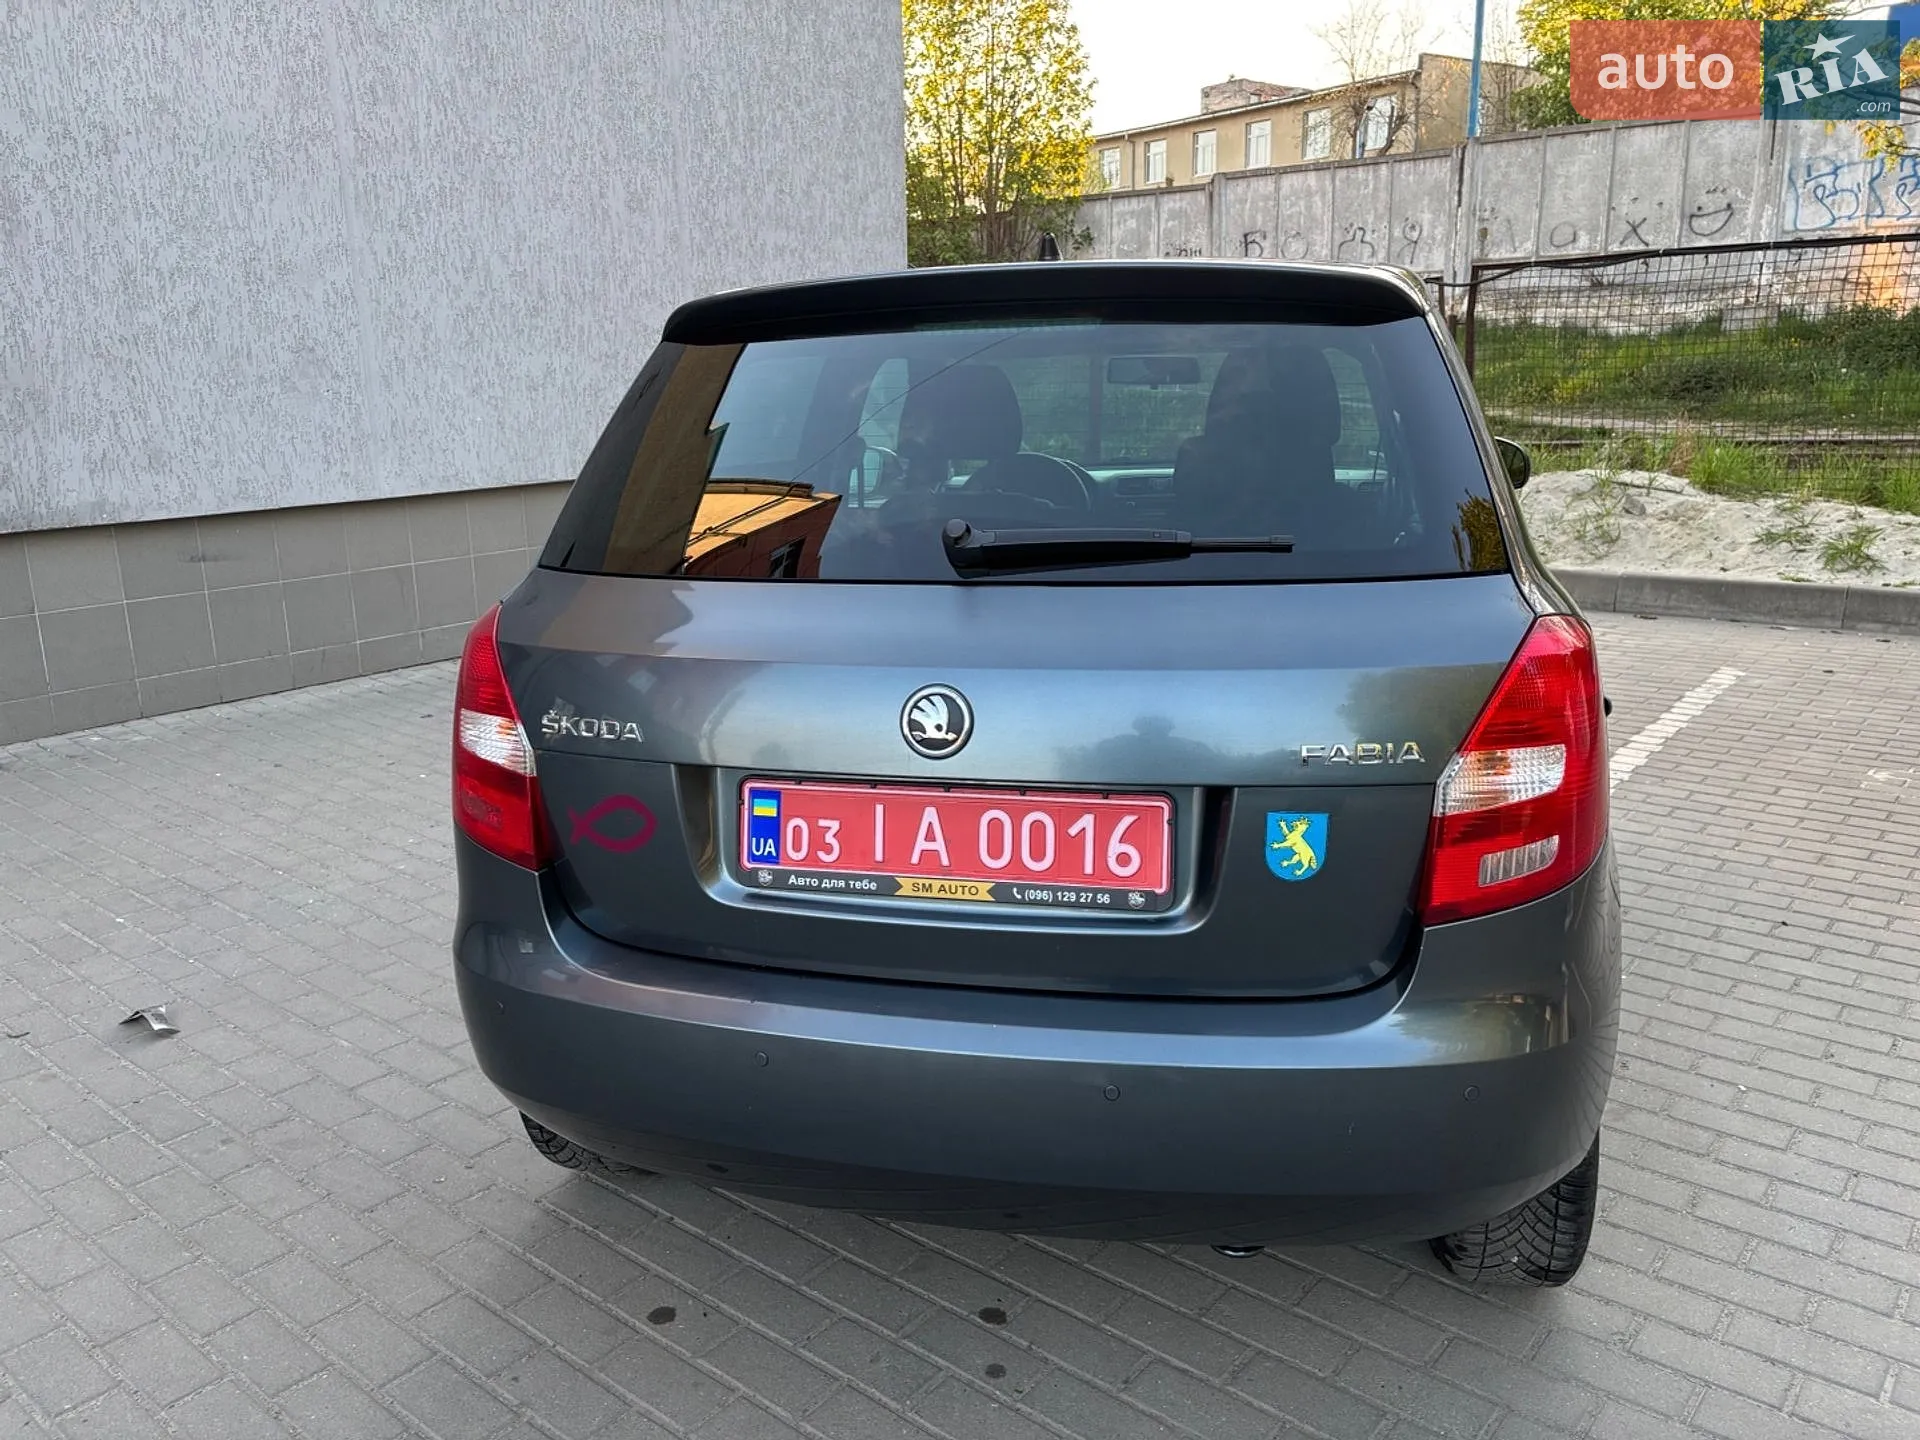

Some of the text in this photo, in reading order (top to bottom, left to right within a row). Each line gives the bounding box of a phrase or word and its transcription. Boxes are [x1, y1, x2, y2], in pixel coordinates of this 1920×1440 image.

[541, 708, 644, 743] ŠKODA
[1300, 741, 1426, 767] FABIA
[751, 837, 777, 857] UA
[785, 816, 842, 864] 03
[977, 809, 1143, 878] 0016
[788, 874, 877, 890] Авто для тебе
[911, 882, 979, 897] SM AUTO
[1025, 889, 1111, 904] (096) 129 27 56
